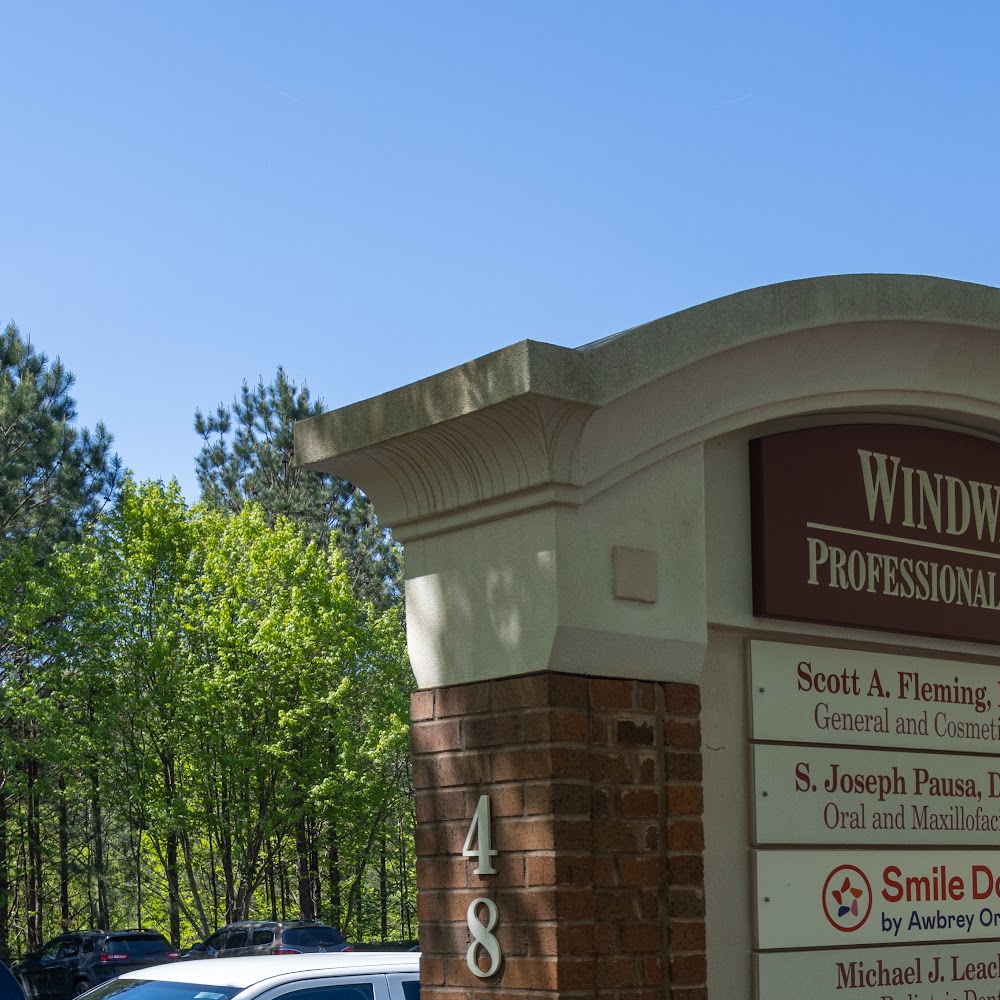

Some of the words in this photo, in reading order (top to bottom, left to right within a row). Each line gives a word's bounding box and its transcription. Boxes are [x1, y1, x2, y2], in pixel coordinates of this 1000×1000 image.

[798, 662, 860, 695] Scott
[867, 669, 890, 698] A.
[897, 672, 991, 713] Fleming,
[815, 703, 889, 733] General
[896, 711, 928, 735] and
[796, 763, 816, 792] S.
[825, 765, 907, 801] Joseph
[914, 768, 982, 798] Pausa,
[824, 803, 866, 829] Oral
[873, 805, 905, 829] and
[882, 866, 964, 902] Smile
[882, 912, 902, 936] by
[908, 910, 974, 932] Awbrey
[836, 958, 922, 989] Michael
[928, 957, 944, 983] J.
